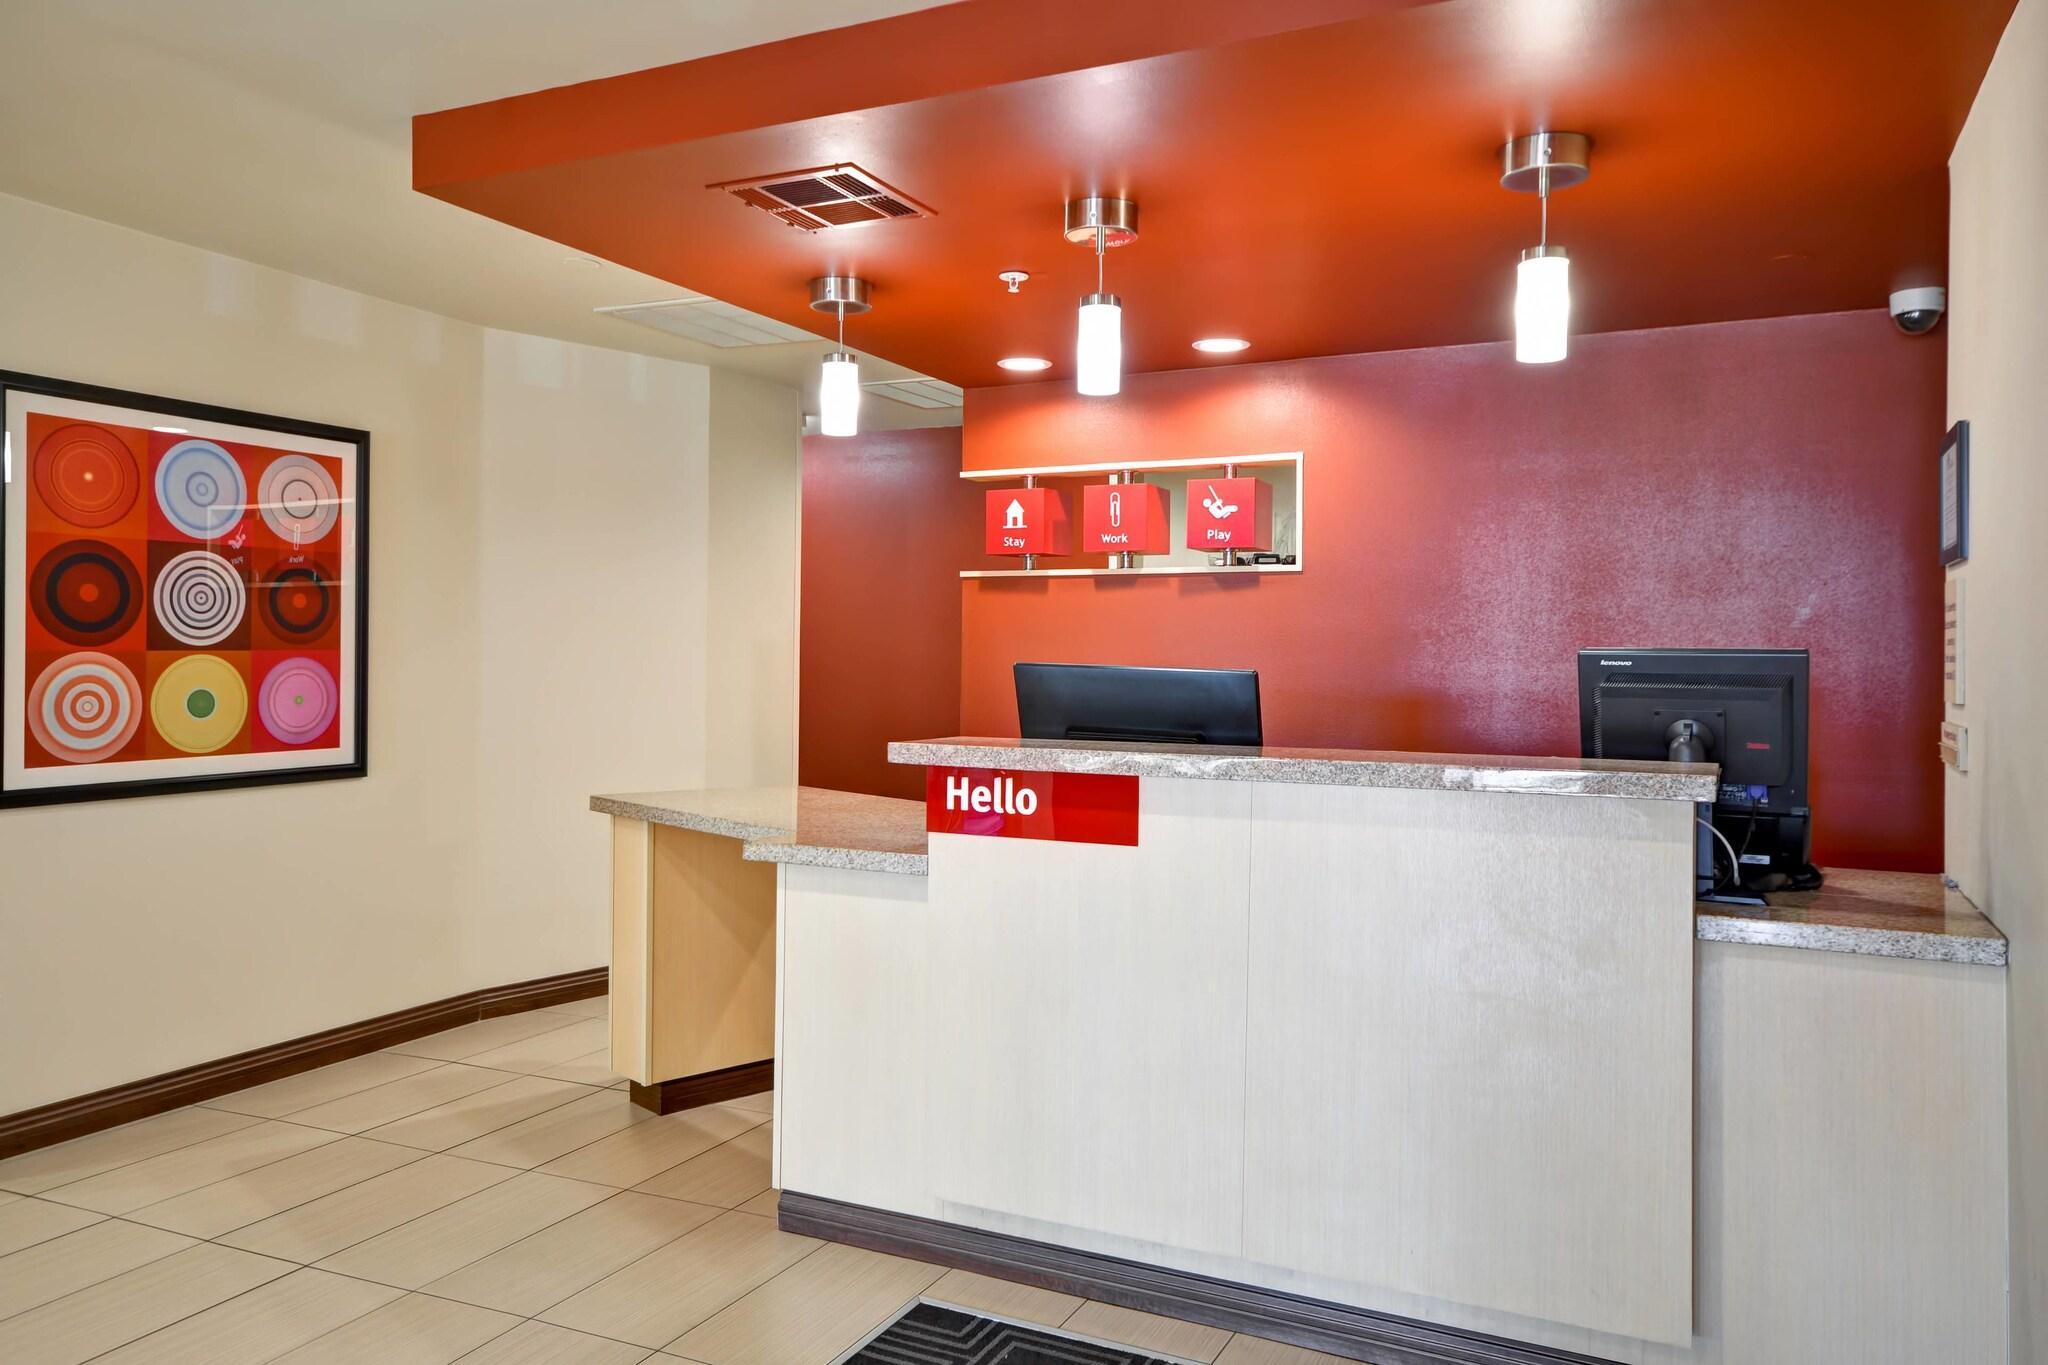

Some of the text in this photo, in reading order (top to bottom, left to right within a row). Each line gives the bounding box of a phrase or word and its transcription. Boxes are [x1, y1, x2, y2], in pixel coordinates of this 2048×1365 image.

[1003, 536, 1025, 548] Stay
[1101, 533, 1128, 543] Work
[1207, 529, 1231, 543] Play
[946, 775, 1038, 816] Hello
